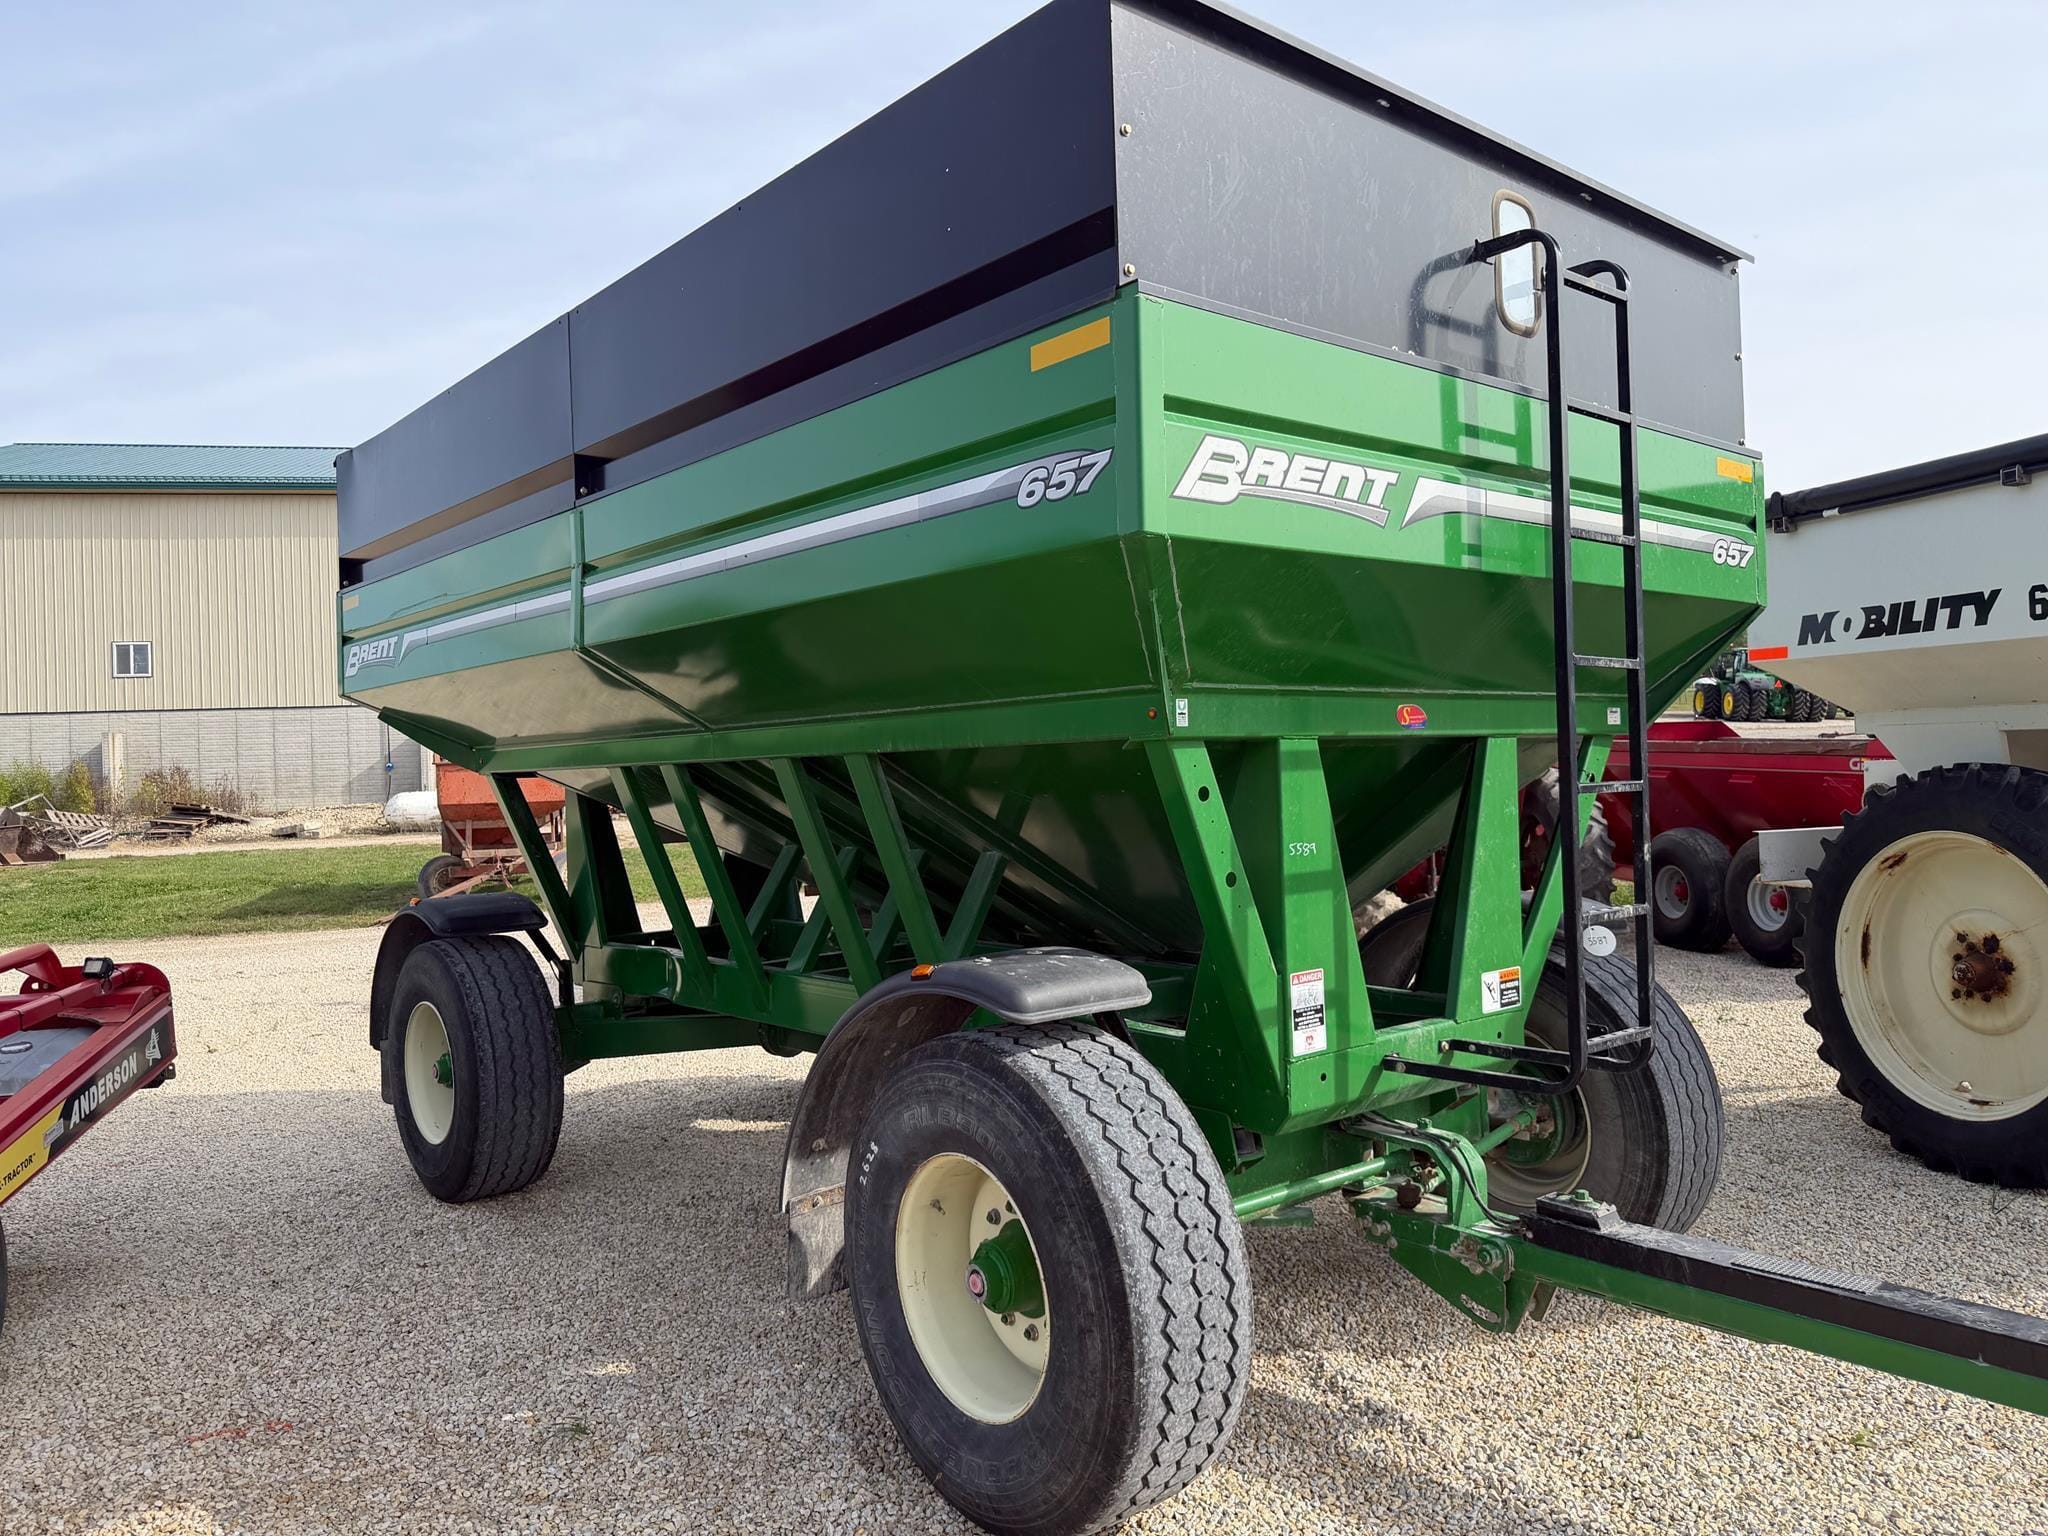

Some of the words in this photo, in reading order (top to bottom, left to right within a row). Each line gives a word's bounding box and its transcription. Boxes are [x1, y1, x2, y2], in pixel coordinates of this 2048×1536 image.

[1017, 448, 1114, 508] 657
[1169, 433, 1401, 508] BRENT
[1713, 539, 1755, 568] 657
[1797, 587, 2003, 646] MOBILITY
[345, 635, 399, 677] BRENT
[1289, 842, 1317, 856] 5589
[69, 1051, 137, 1130] ANDERSON
